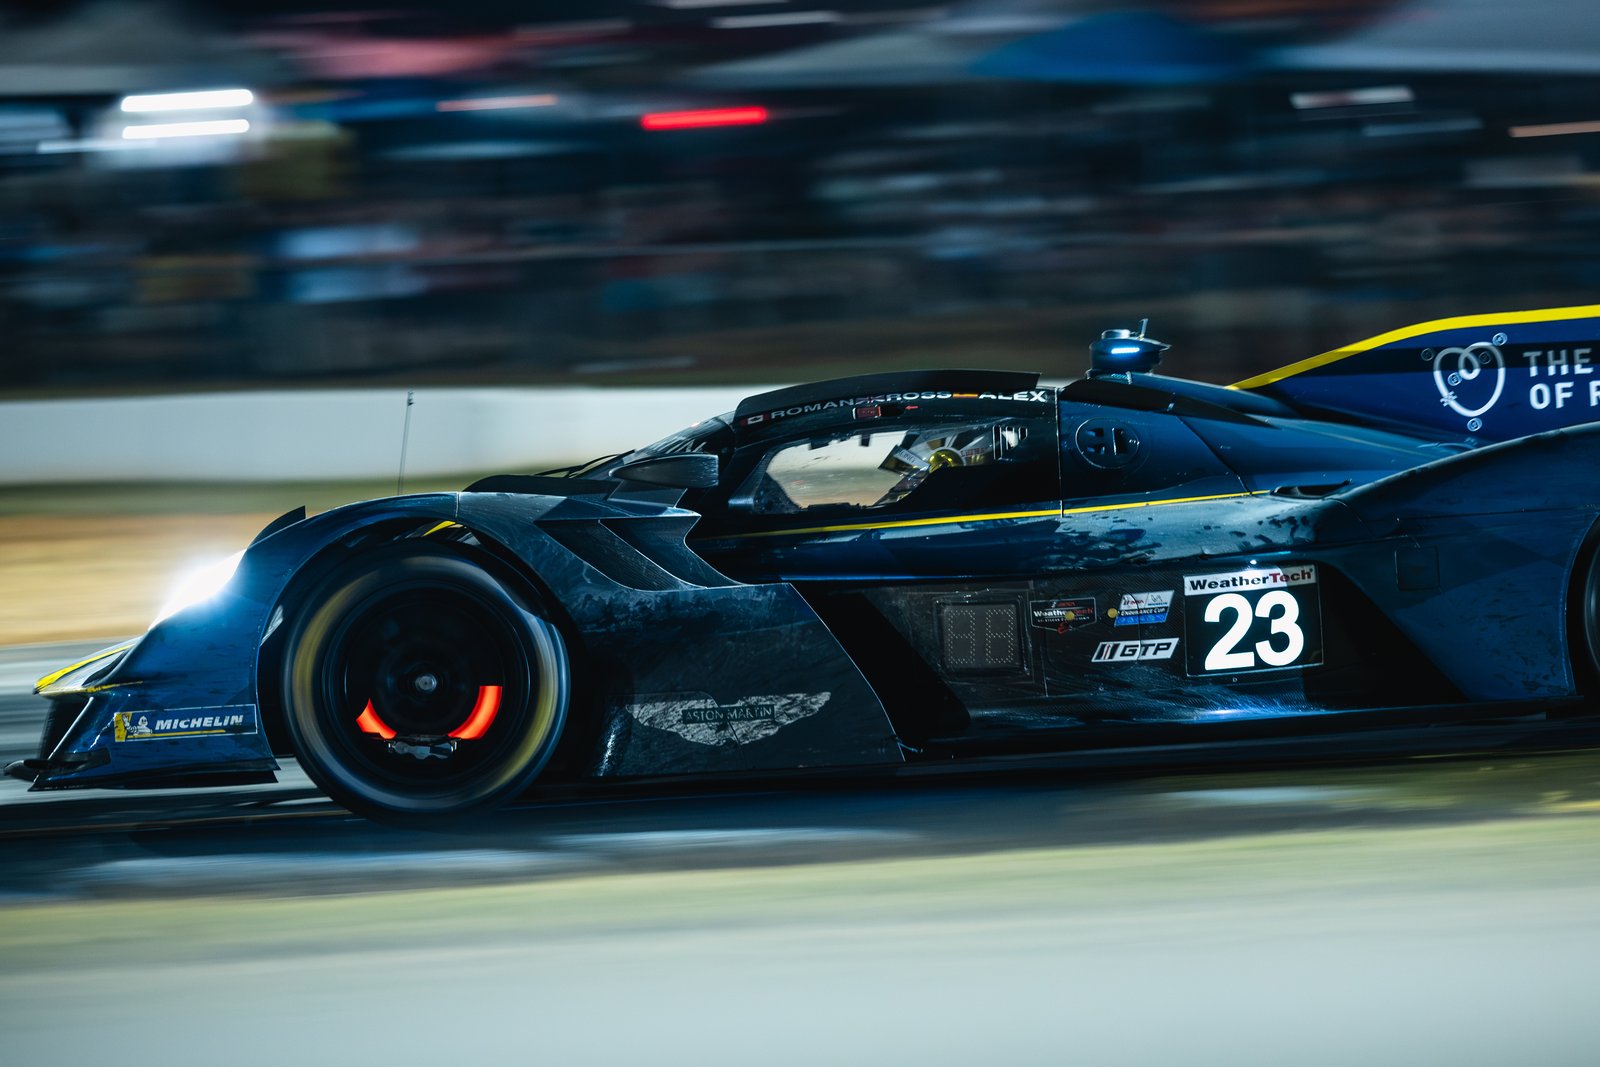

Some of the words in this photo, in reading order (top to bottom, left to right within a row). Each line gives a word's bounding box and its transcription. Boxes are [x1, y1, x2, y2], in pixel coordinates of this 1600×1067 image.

[1523, 348, 1594, 377] THE
[886, 390, 952, 401] ROSS
[1529, 381, 1574, 410] OF
[770, 398, 854, 420] ROMAN
[1189, 569, 1312, 591] WeatherTech
[1033, 607, 1093, 617] WeatheTech
[1204, 590, 1305, 671] 23
[1119, 642, 1172, 657] GTP
[155, 714, 244, 731] MICHELIN
[685, 710, 724, 722] ASTON
[727, 707, 772, 720] MARTIN
